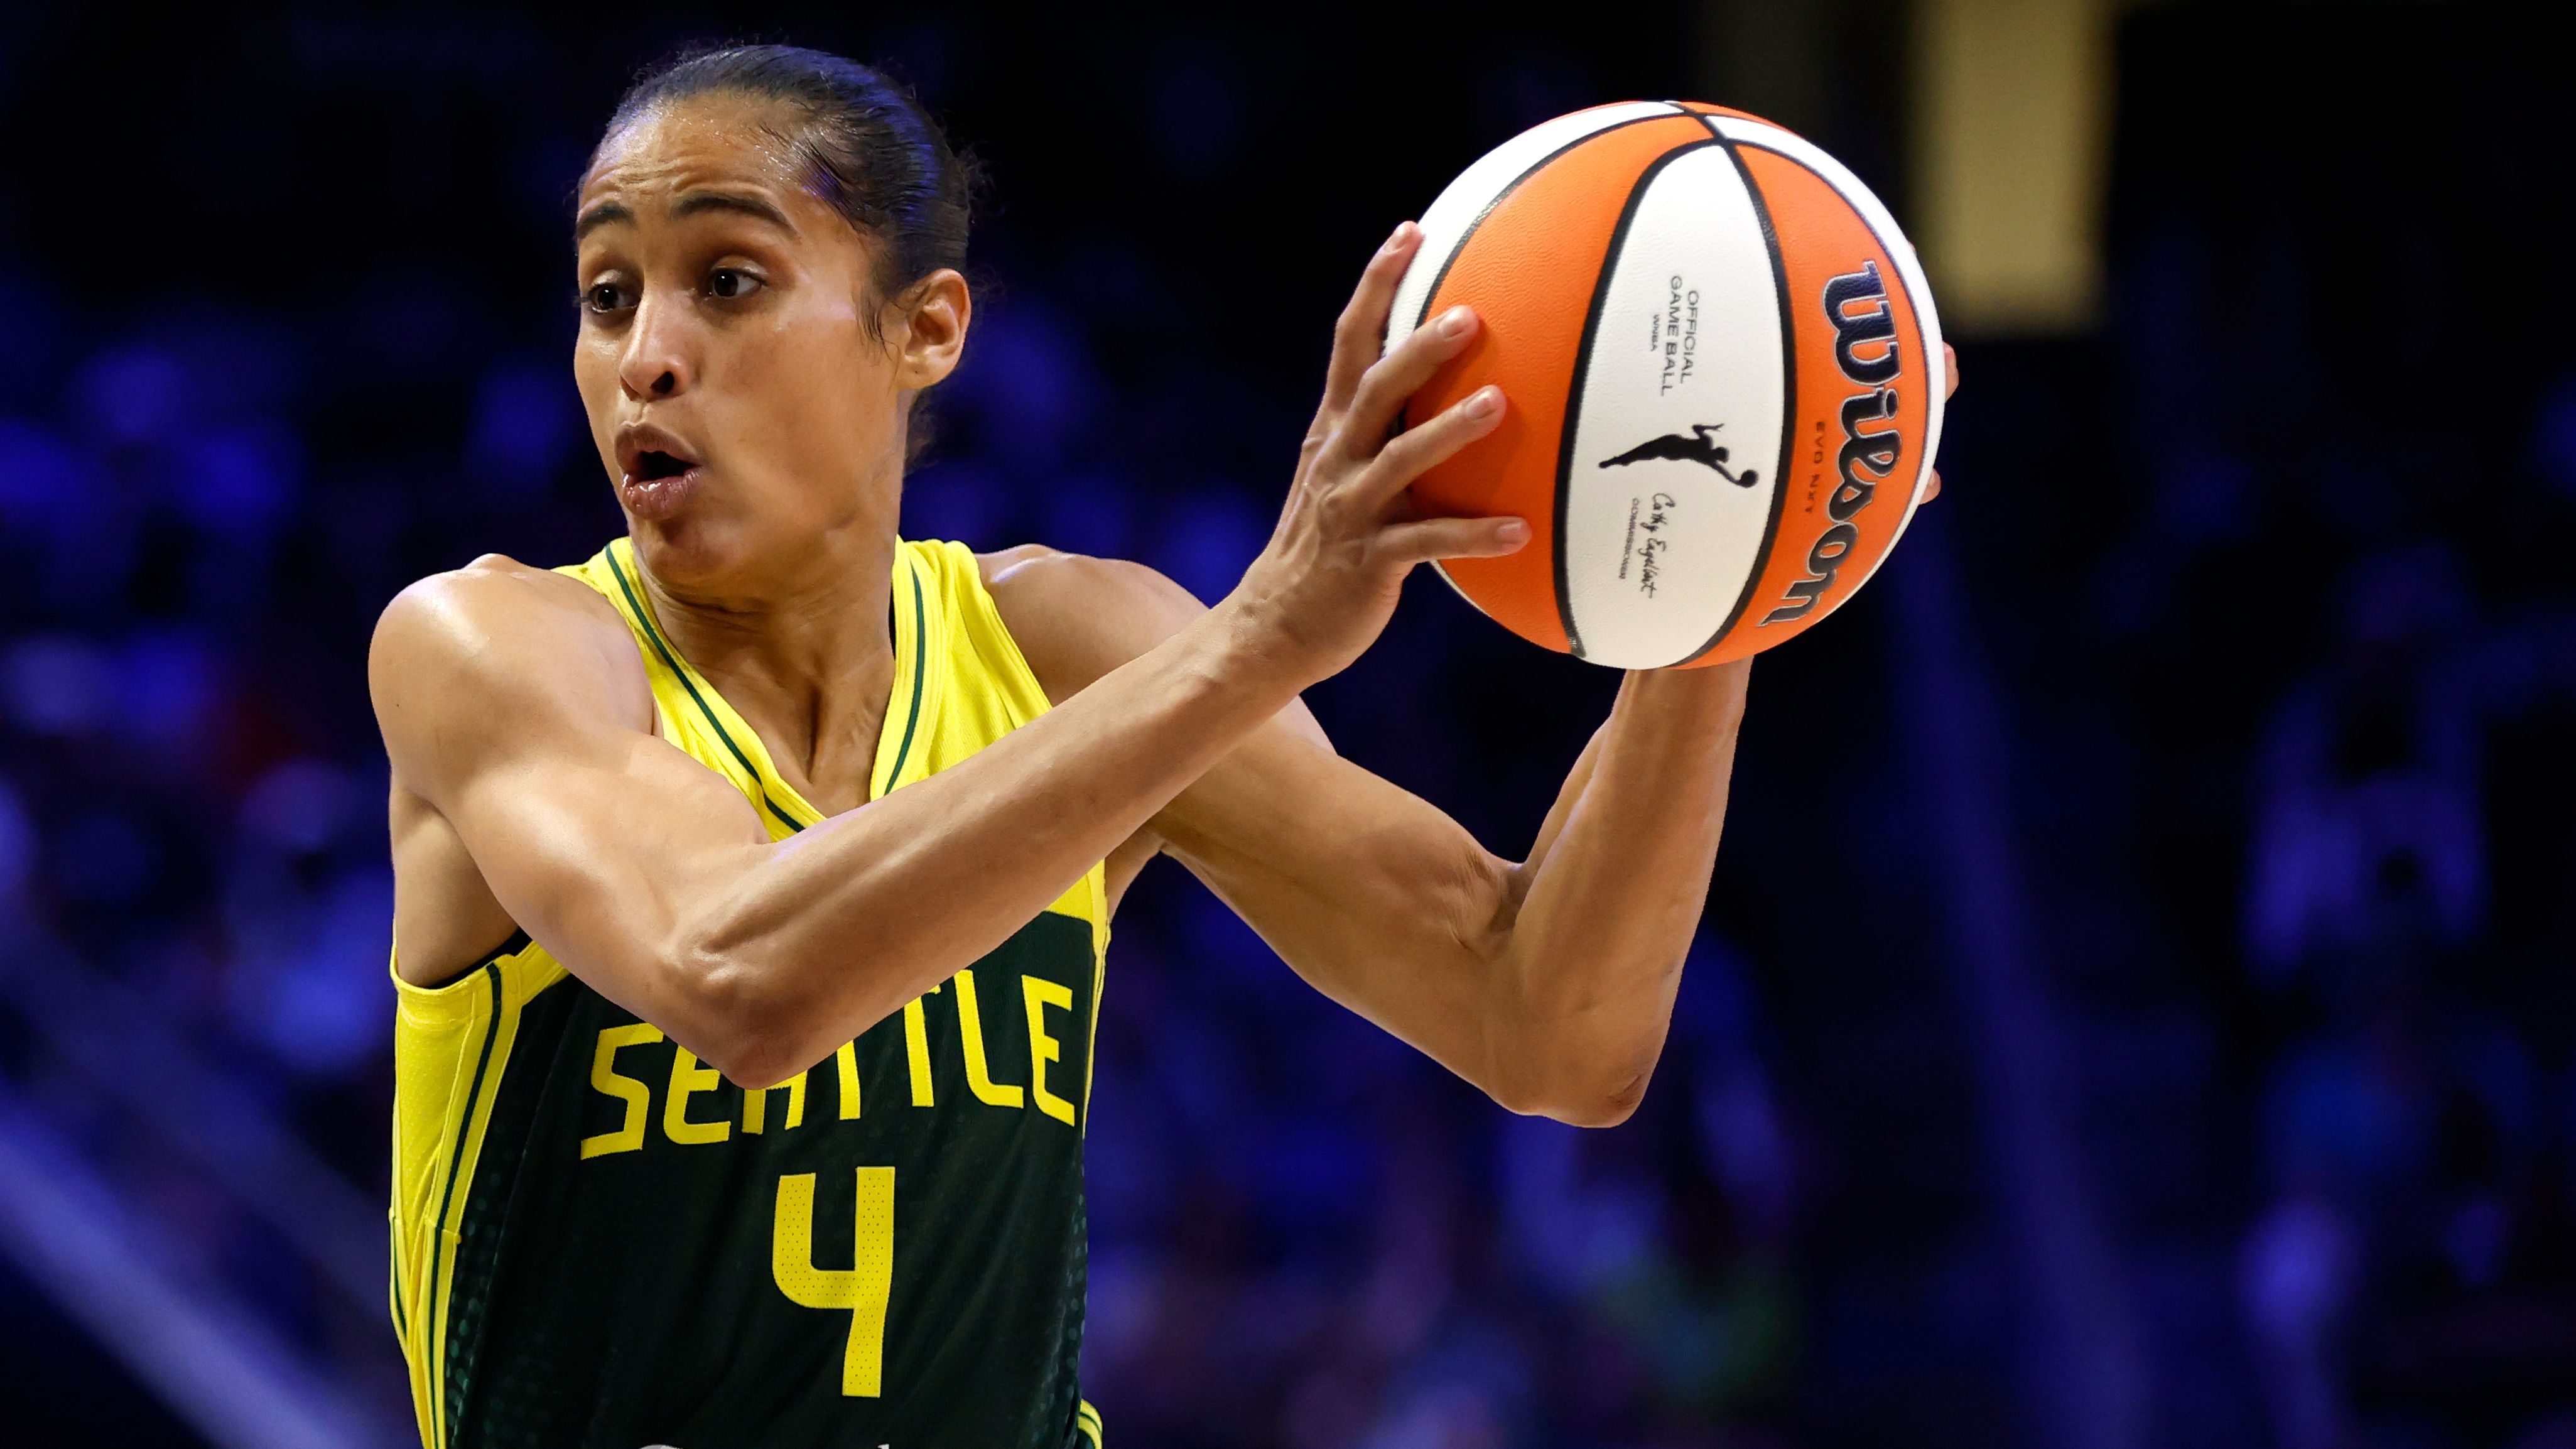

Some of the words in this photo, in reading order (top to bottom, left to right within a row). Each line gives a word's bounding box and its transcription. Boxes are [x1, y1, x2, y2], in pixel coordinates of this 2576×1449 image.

[1650, 314, 1660, 352] WNBA
[1667, 275, 1682, 336] GAME
[1680, 290, 1699, 383] OFFICIAL
[1660, 342, 1677, 396] BALL
[1757, 260, 1902, 627] Wilson
[1813, 420, 1826, 466] EVO
[1804, 473, 1821, 514] NXT
[772, 1166, 896, 1397] 4
